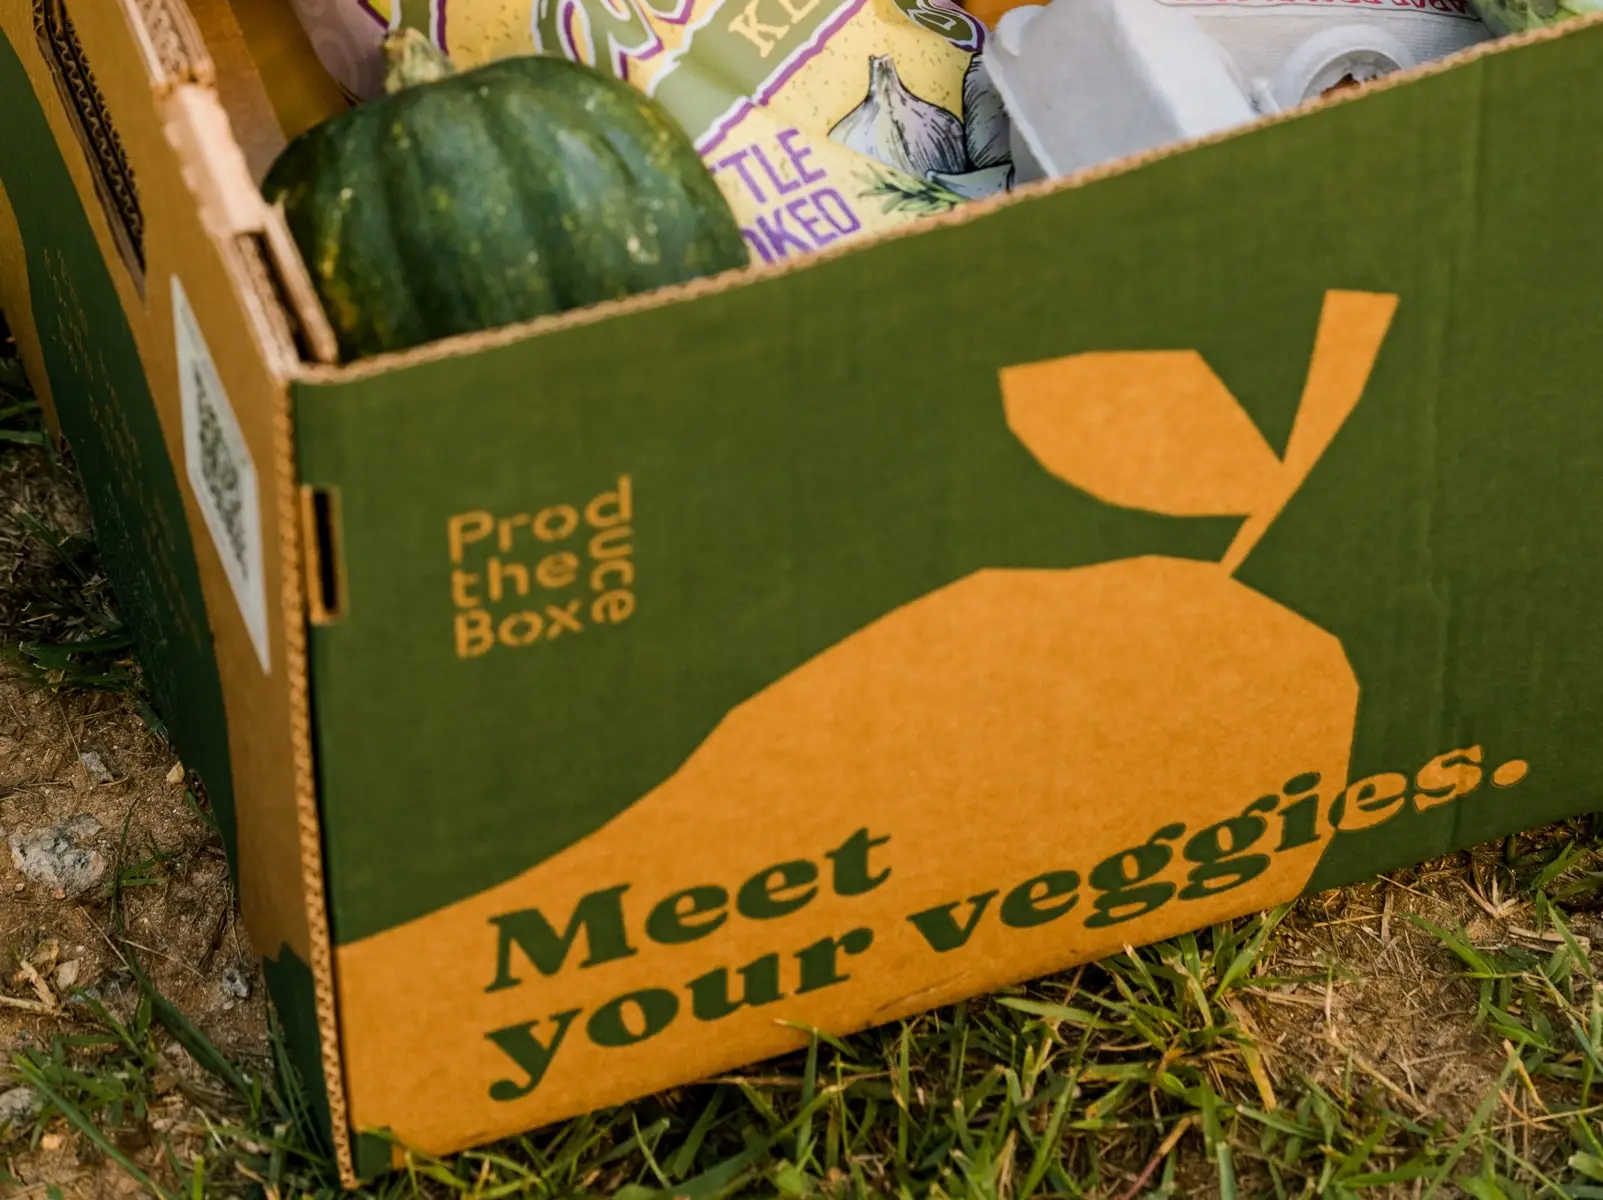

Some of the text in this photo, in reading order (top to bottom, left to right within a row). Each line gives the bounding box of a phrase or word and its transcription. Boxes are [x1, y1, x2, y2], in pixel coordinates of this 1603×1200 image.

[708, 128, 827, 204] TLE
[452, 552, 579, 608] the
[455, 600, 583, 658] Box
[484, 827, 892, 993] Meet
[484, 744, 1528, 1102] your veggies.
